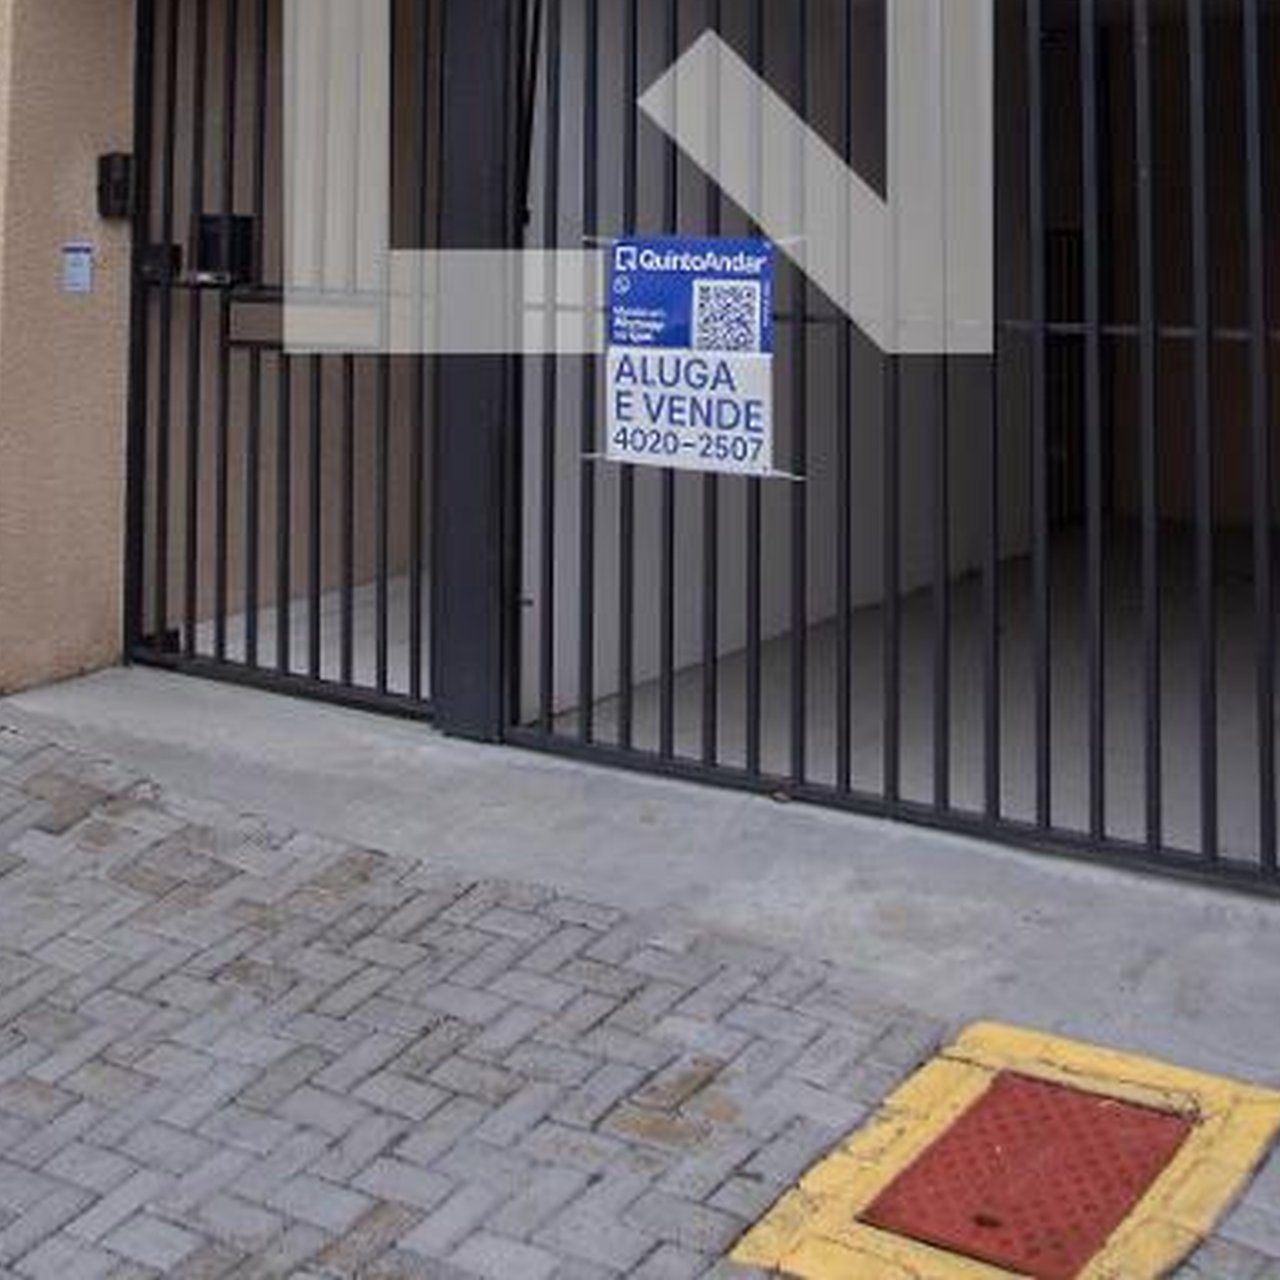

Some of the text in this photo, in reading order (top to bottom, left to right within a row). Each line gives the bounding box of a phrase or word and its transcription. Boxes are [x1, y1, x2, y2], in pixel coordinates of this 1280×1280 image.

[638, 249, 768, 273] QuintoAndar
[614, 354, 736, 391] ALUGA
[615, 390, 764, 433] E VENDE
[613, 427, 764, 462] 4020-2507
